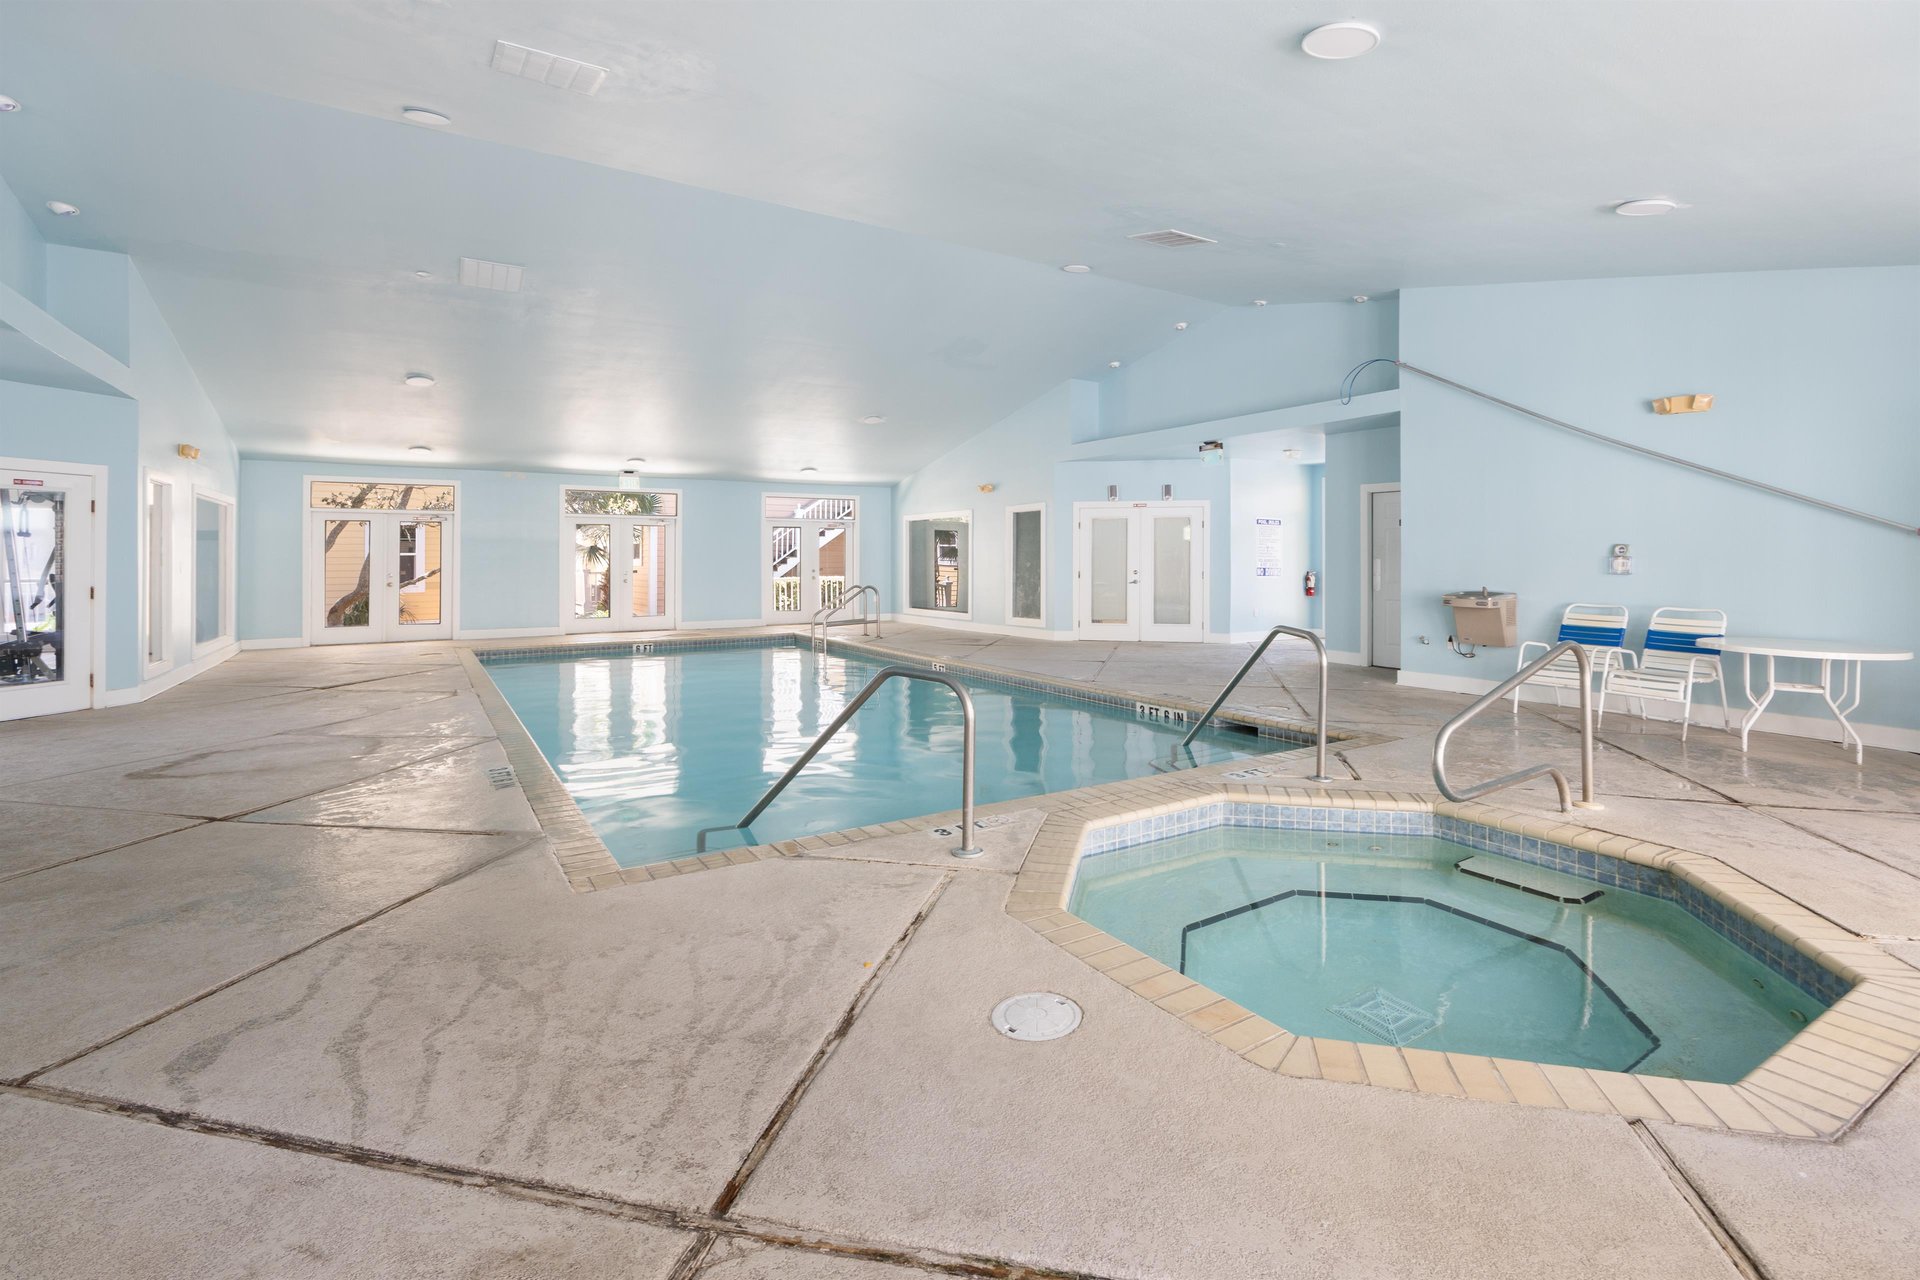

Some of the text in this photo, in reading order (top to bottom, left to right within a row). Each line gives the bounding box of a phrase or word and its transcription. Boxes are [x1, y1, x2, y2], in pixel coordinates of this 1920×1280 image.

[1149, 706, 1160, 716] FT
[1173, 711, 1184, 721] IN
[933, 828, 953, 836] 3
